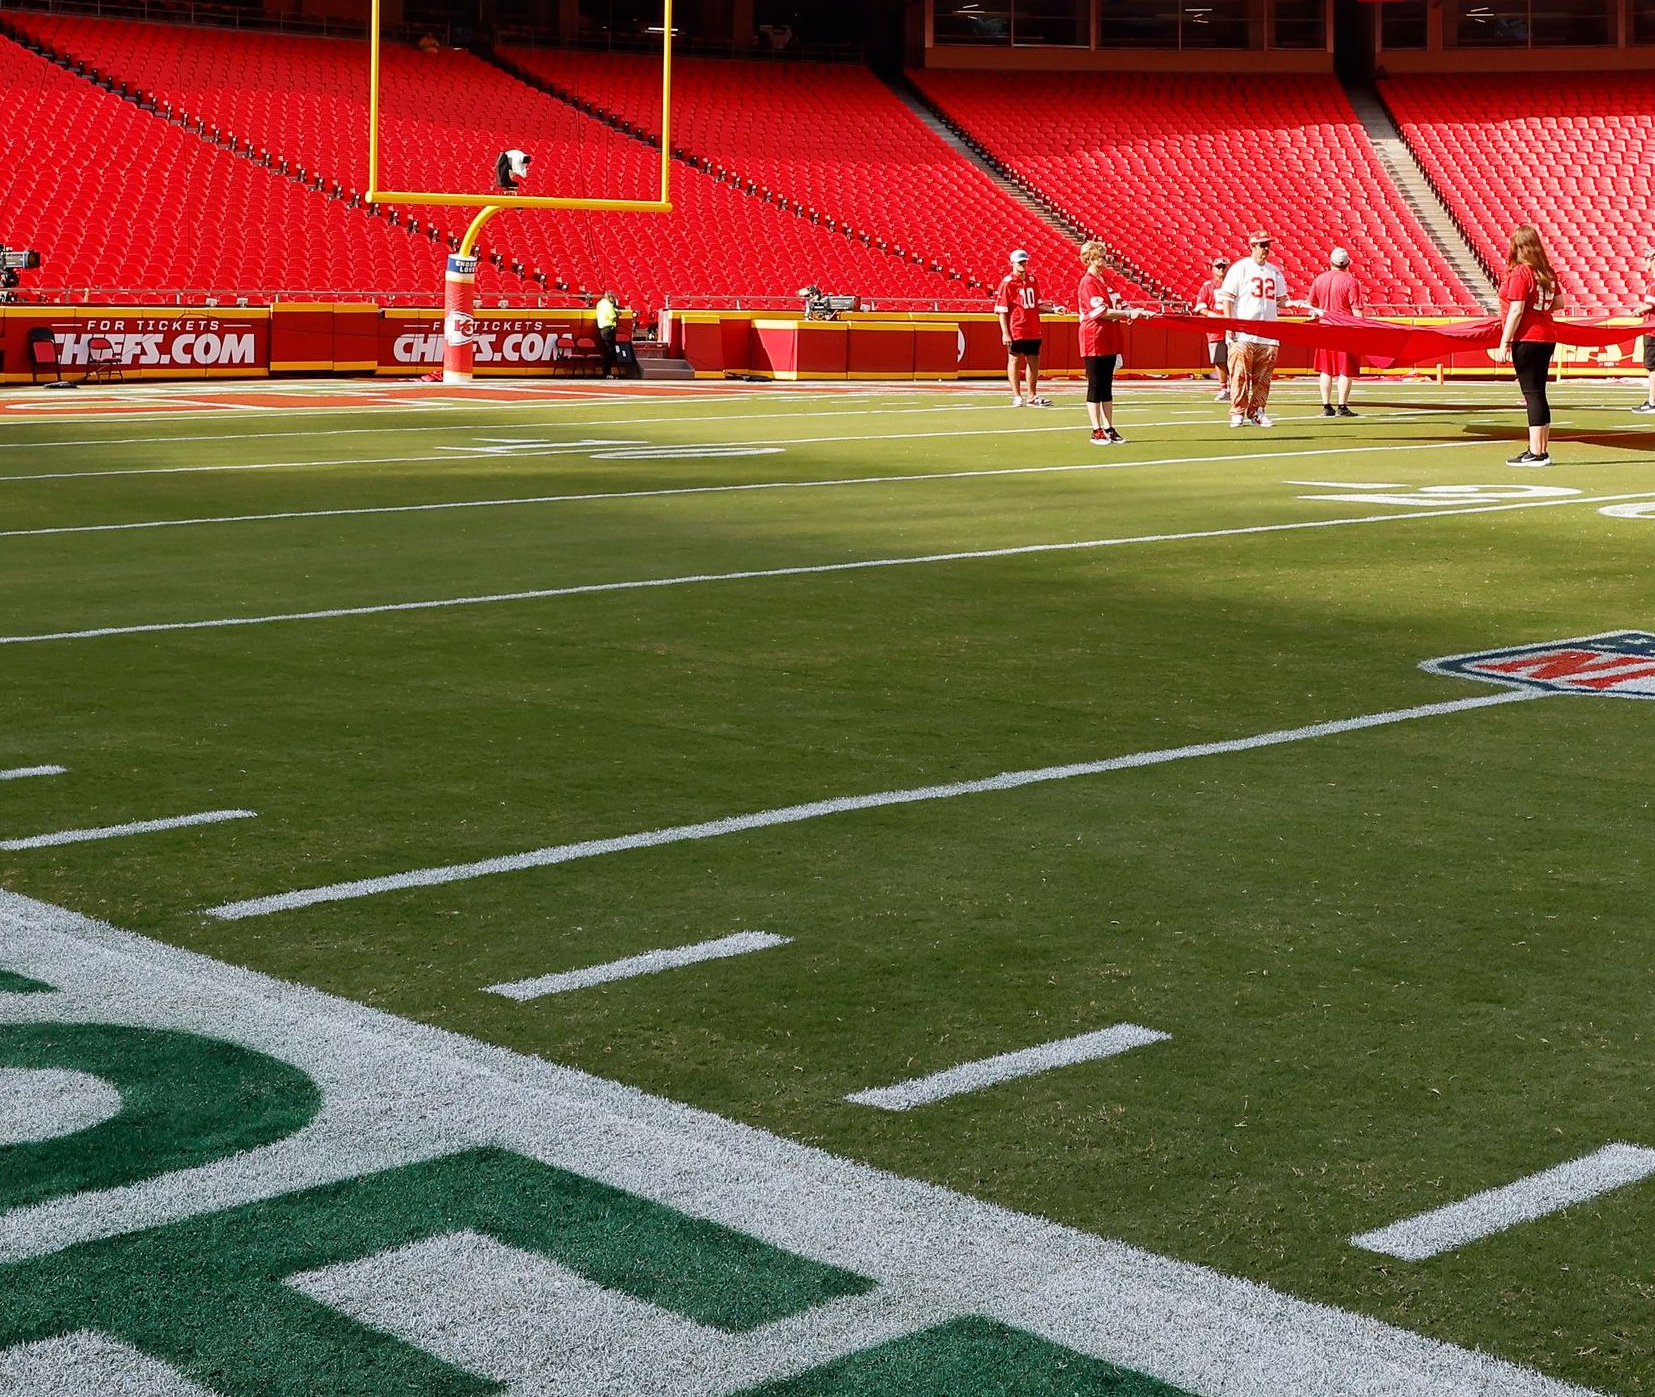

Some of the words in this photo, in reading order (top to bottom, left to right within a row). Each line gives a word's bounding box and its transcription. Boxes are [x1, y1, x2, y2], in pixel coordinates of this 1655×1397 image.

[1251, 277, 1276, 299] 32
[1019, 287, 1035, 309] 10
[88, 321, 125, 330] FOR
[137, 321, 220, 330] TICKETS
[474, 322, 543, 331] TICKETS
